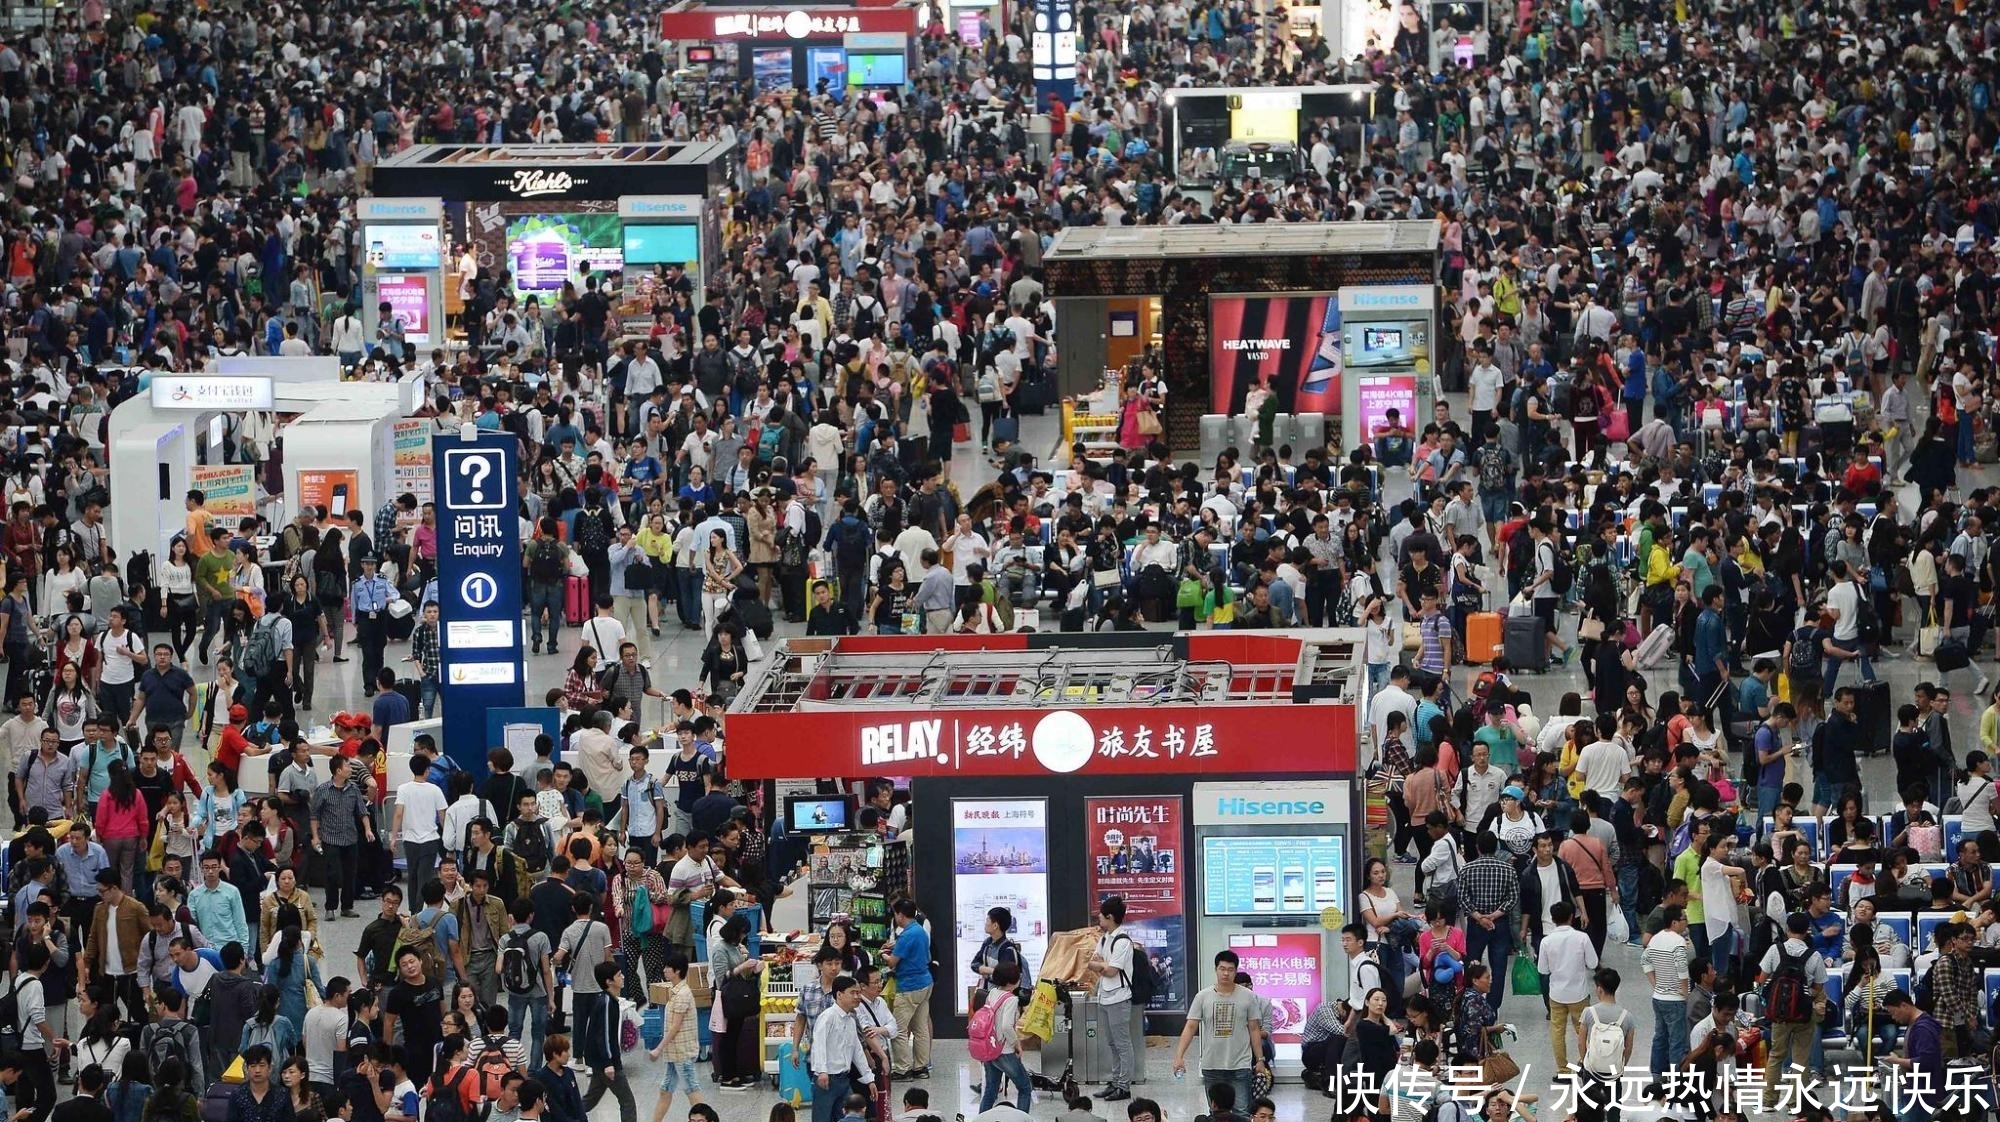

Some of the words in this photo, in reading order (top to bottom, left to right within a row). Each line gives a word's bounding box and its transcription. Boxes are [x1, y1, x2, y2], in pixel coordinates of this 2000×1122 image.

[510, 169, 573, 194] Kiehl's
[370, 203, 427, 215] Hisense
[631, 202, 687, 212] Hisense
[1353, 294, 1419, 305] Hisense
[1223, 339, 1291, 350] HEATWAVE
[1247, 352, 1269, 360] VASTO
[454, 515, 502, 538] 问讯
[454, 542, 504, 557] Enquiry
[966, 724, 1027, 759] 经纬
[1098, 724, 1218, 759] 旅友书屋
[1218, 797, 1325, 816] Hisense
[1004, 809, 1035, 819] 上海符号
[1096, 805, 1170, 824] 时尚先生
[1252, 972, 1312, 986] 苏宁易购
